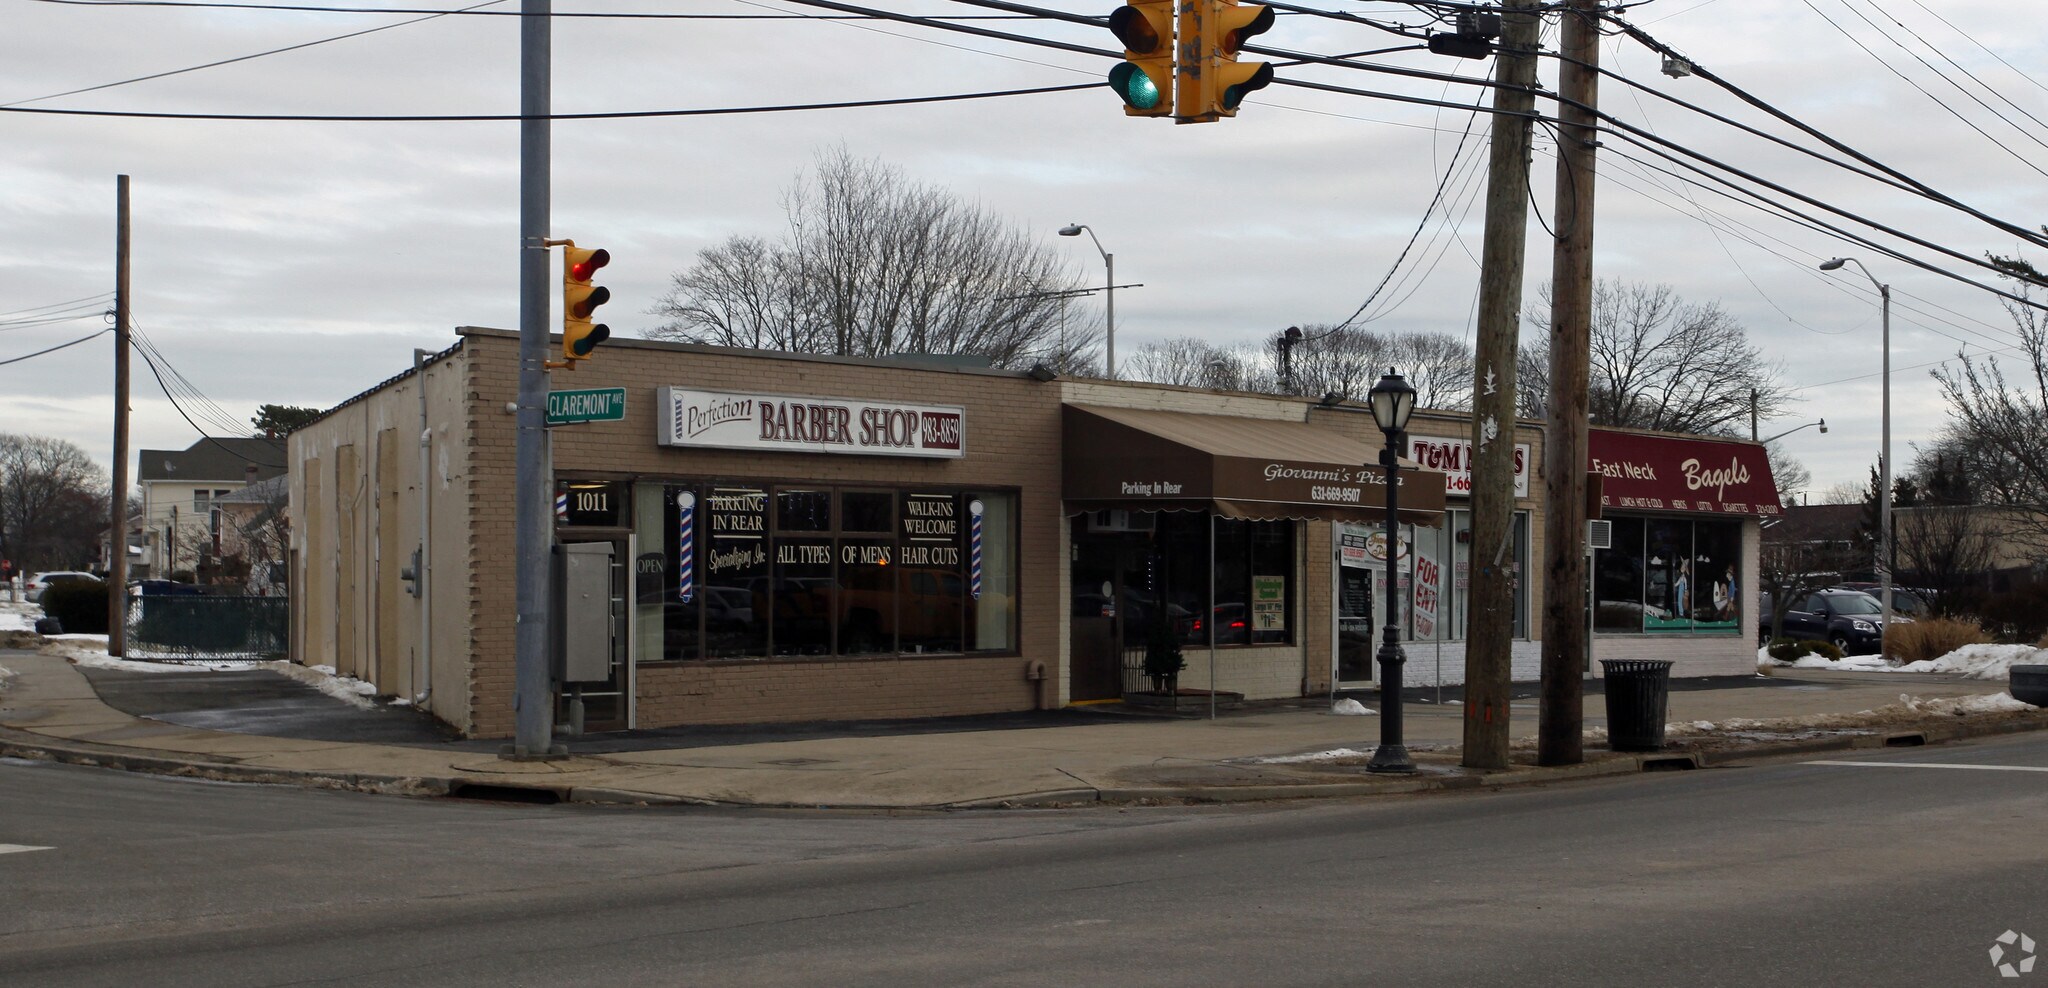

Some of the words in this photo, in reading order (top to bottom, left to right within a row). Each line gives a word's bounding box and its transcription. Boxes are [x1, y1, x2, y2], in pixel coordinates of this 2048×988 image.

[549, 393, 611, 416] CLAREMONT
[611, 392, 623, 404] AVE
[686, 397, 753, 434] Perfection
[759, 401, 853, 445] BARBER
[859, 407, 920, 448] SHOP
[922, 418, 960, 444] 983-8859
[1413, 441, 1461, 472] T&M
[1264, 463, 1351, 483] Giovanni's
[1592, 458, 1623, 478] East
[1623, 461, 1657, 481] Neck
[1681, 456, 1751, 502] Bagels
[1121, 481, 1152, 496] Parking
[1153, 481, 1161, 494] In
[1163, 482, 1182, 494] Rear
[1311, 486, 1361, 502] 631-669-9507
[576, 492, 608, 511] 1011
[711, 496, 764, 512] PARKING
[907, 501, 953, 517] WALK-INS
[1696, 501, 1713, 512] LOTTO
[1722, 503, 1749, 514] CIGARETTES
[712, 515, 728, 530] IN
[731, 515, 763, 531] REAR
[904, 519, 956, 535] WELCOME
[709, 546, 752, 574] Specializing
[777, 546, 797, 564] ALL
[799, 545, 831, 564] TYPES
[842, 545, 857, 564] OF
[860, 546, 891, 565] MENS
[901, 546, 928, 565] HAIR
[931, 547, 958, 565] CUTS
[636, 559, 663, 574] OPEN
[1415, 584, 1438, 614] ENT
